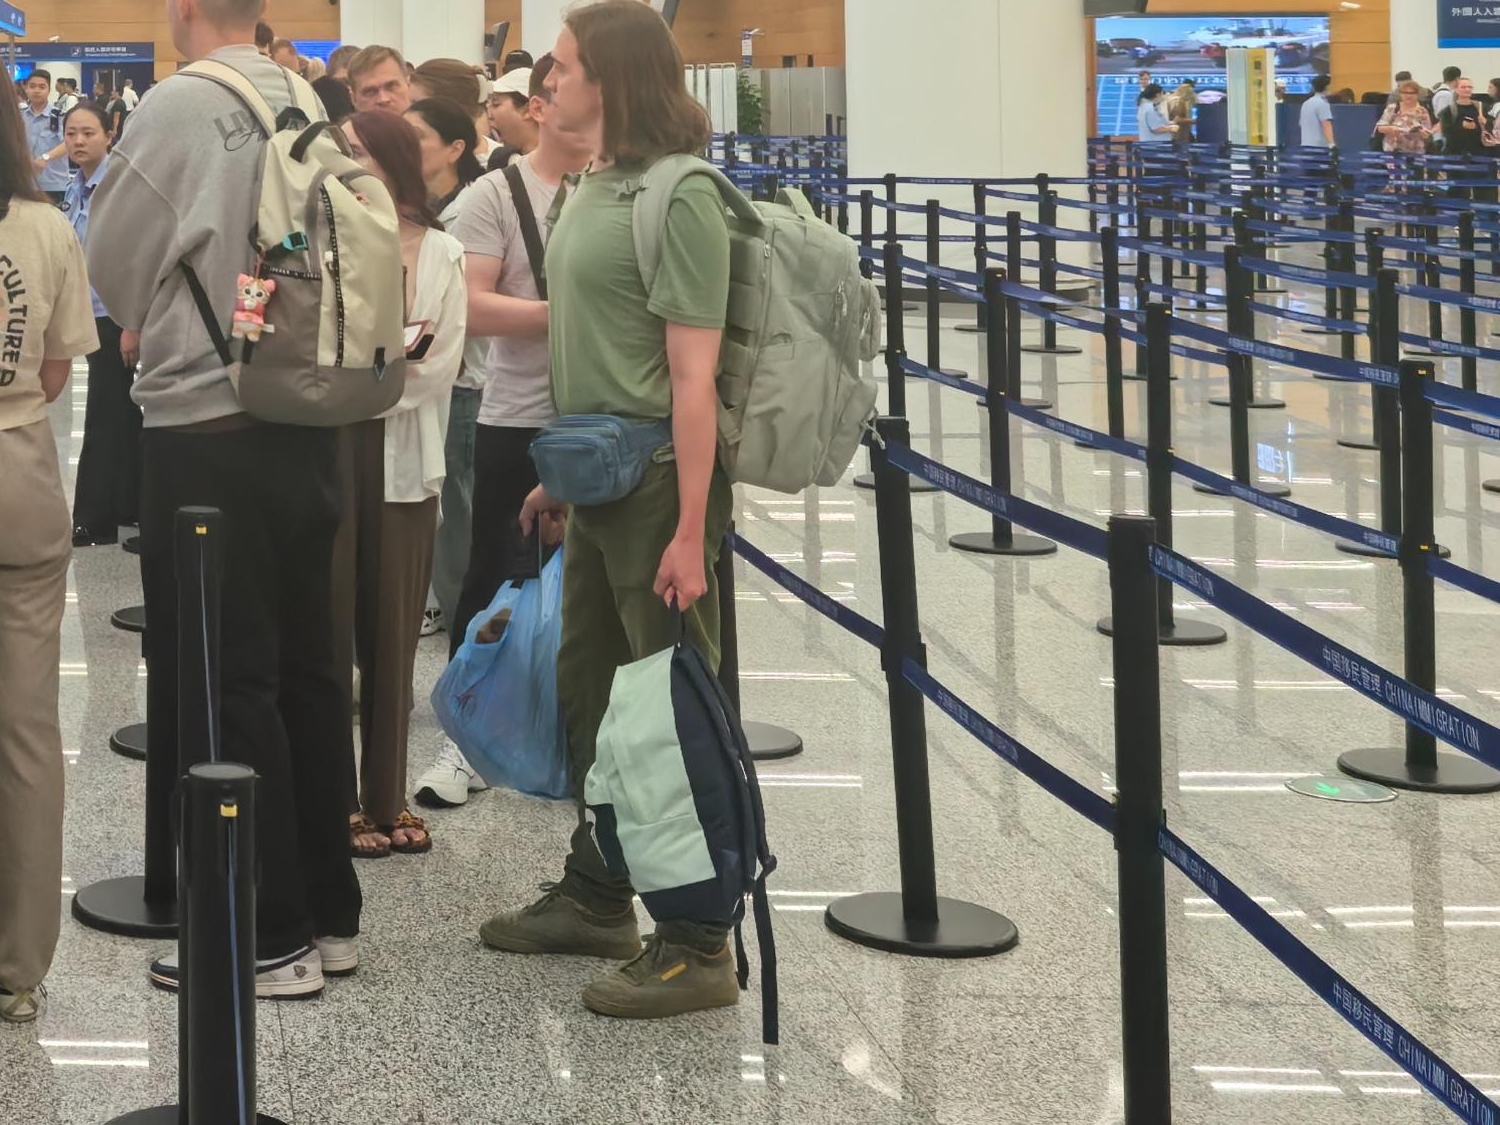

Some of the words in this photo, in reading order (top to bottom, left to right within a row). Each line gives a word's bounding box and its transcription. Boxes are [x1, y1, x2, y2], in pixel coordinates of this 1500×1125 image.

[1322, 644, 1383, 698] 中国移民管理
[1333, 980, 1394, 1050] 中国移民管理
